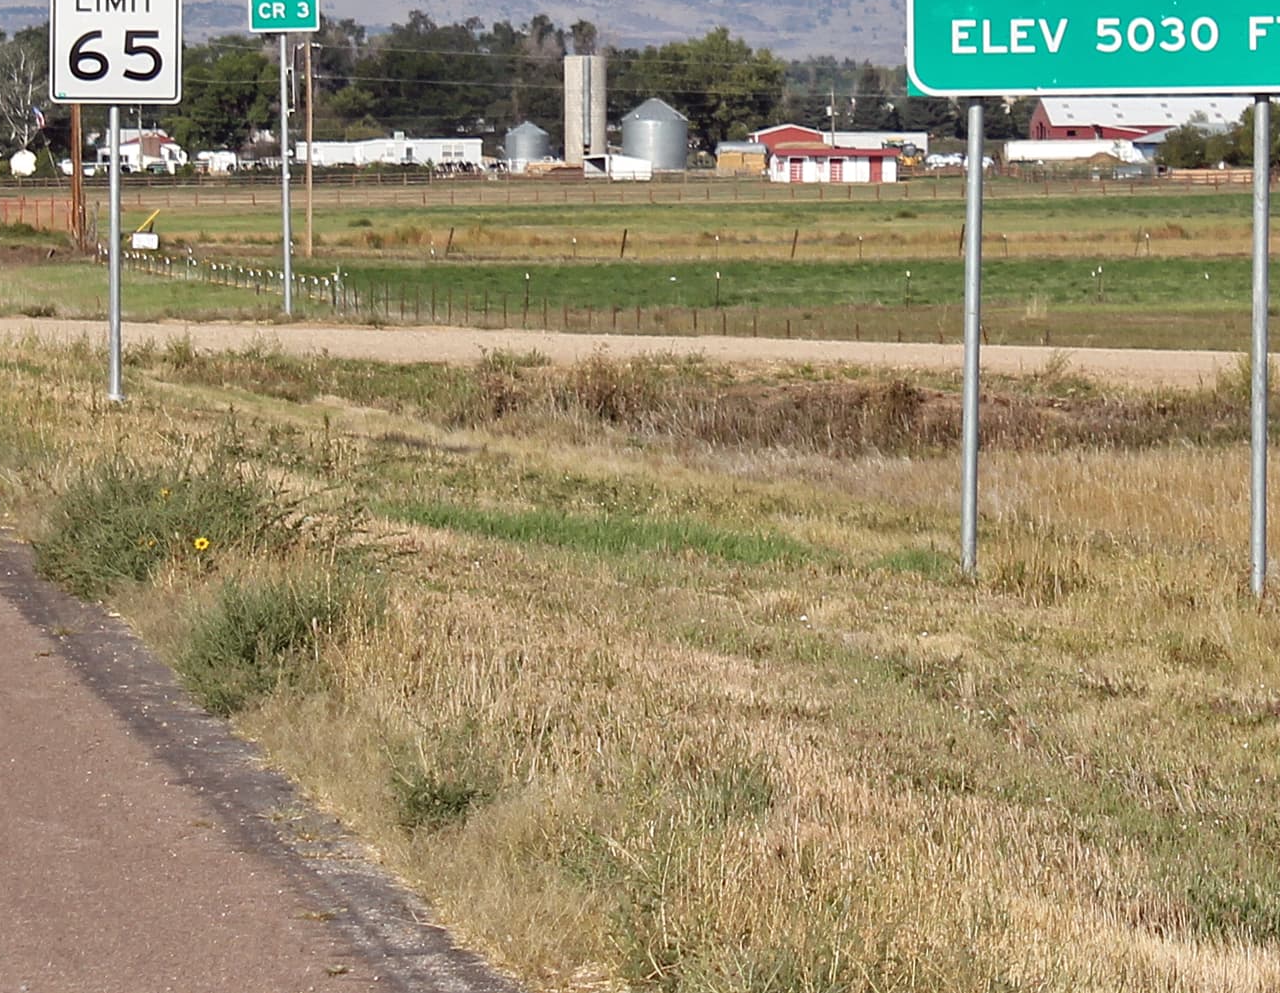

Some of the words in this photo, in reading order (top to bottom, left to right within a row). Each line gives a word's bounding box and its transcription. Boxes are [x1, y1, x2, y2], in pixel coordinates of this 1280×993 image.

[258, 2, 286, 19] CR
[297, 1, 310, 18] 3
[951, 18, 1068, 53] ELEV
[1096, 17, 1218, 52] 5030
[68, 29, 163, 81] 65
